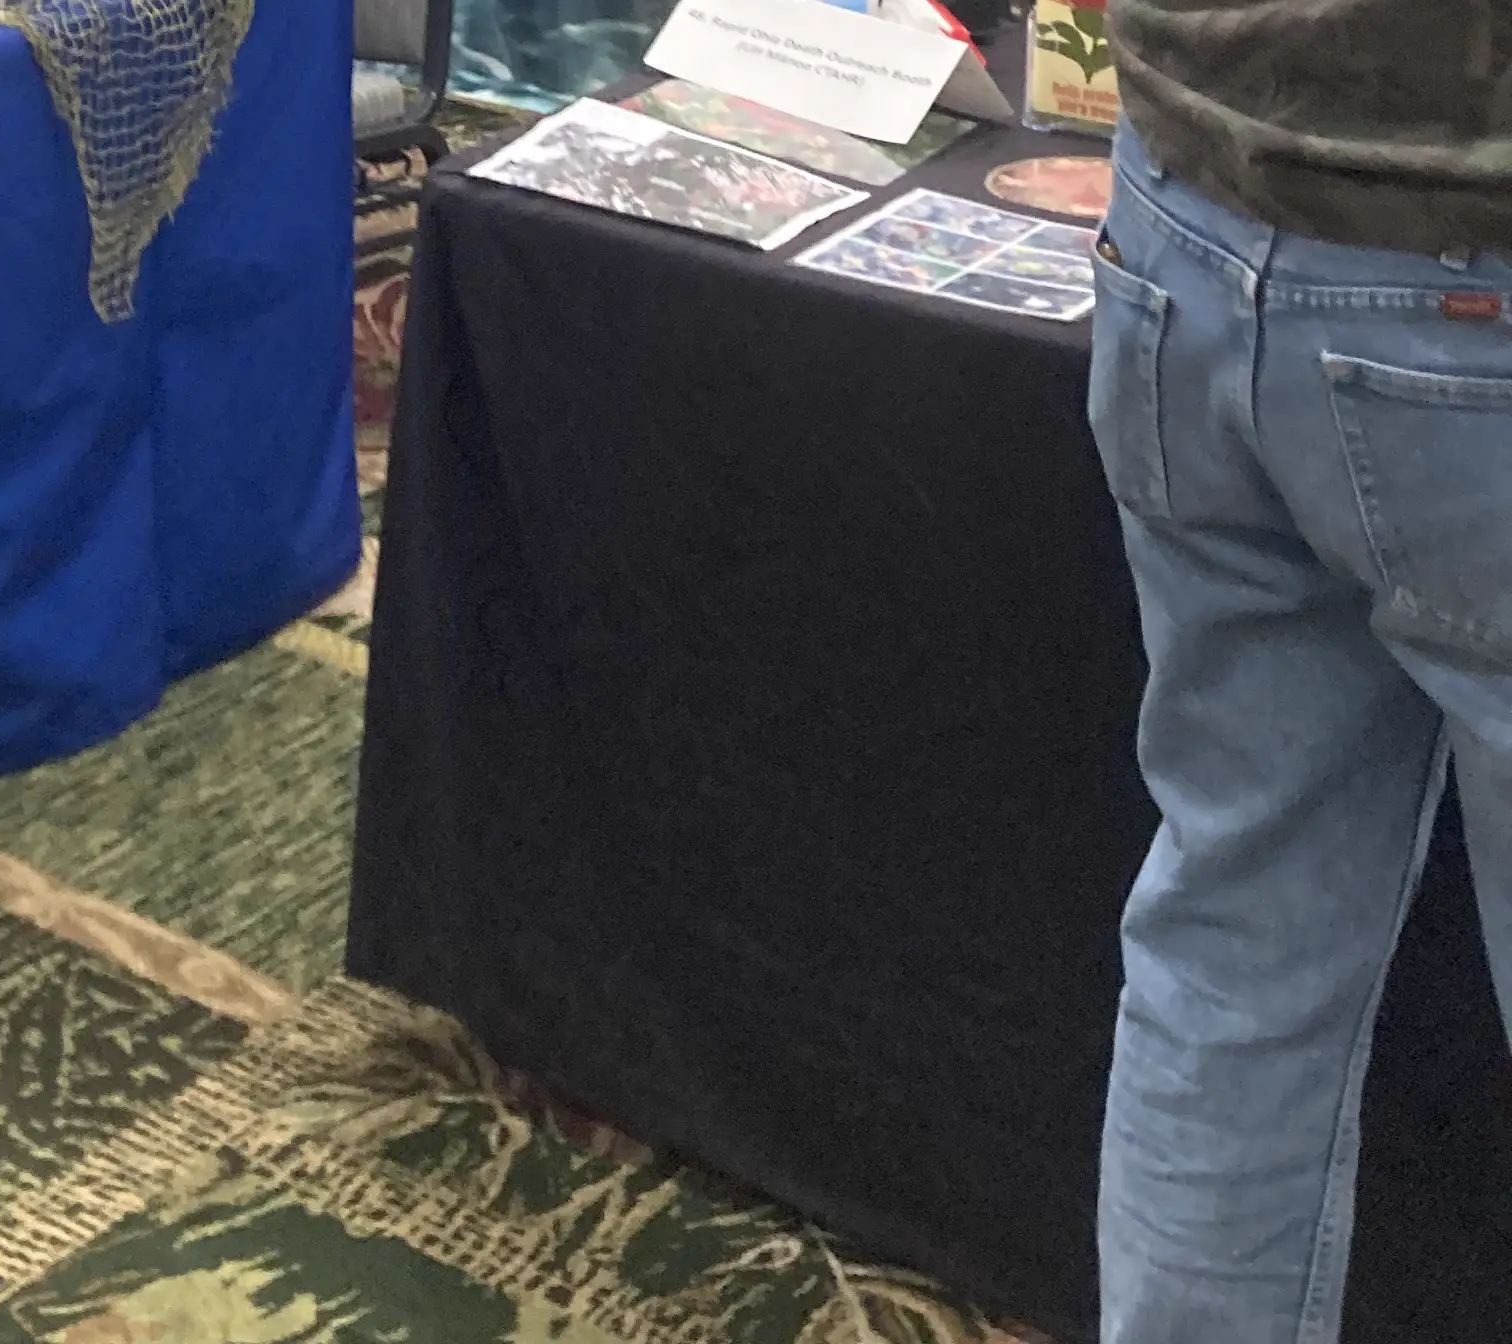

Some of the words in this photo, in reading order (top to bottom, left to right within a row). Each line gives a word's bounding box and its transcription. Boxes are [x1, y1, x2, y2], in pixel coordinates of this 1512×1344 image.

[783, 37, 824, 58] Death
[825, 50, 889, 77] Outreach
[891, 69, 933, 87] Booth
